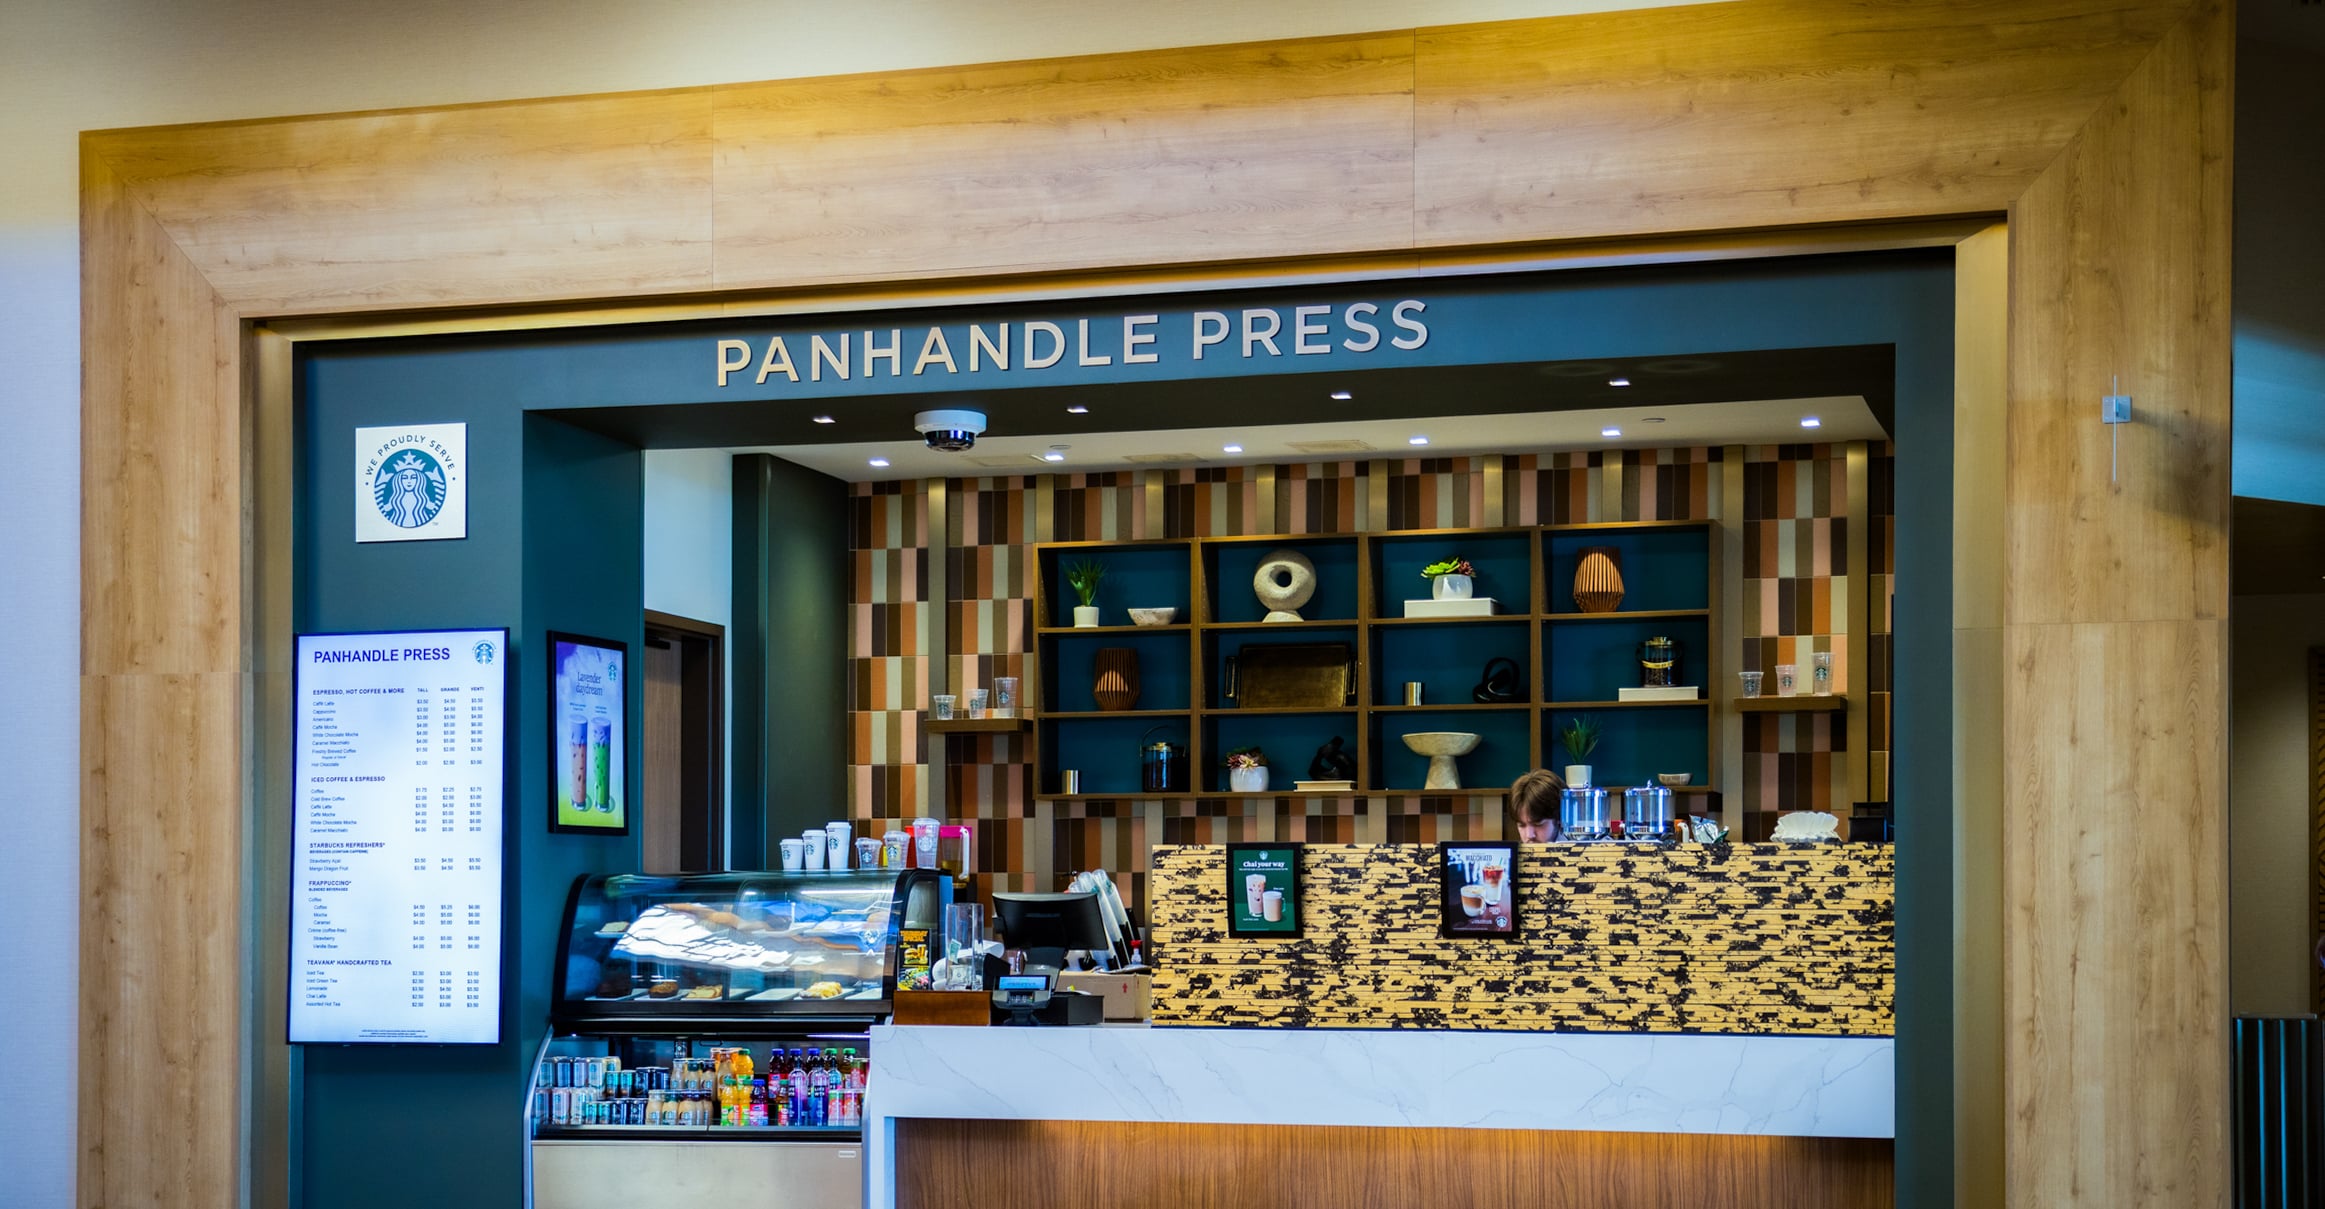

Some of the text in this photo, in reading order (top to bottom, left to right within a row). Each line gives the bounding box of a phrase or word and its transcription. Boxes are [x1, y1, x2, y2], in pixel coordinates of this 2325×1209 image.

[717, 299, 1429, 387] PANHANDLE PRESS
[366, 435, 455, 475] WE PROUDLY SERVE
[314, 648, 450, 663] PANHANDLE PRESS
[578, 672, 601, 683] Lavender
[576, 683, 602, 696] daydream
